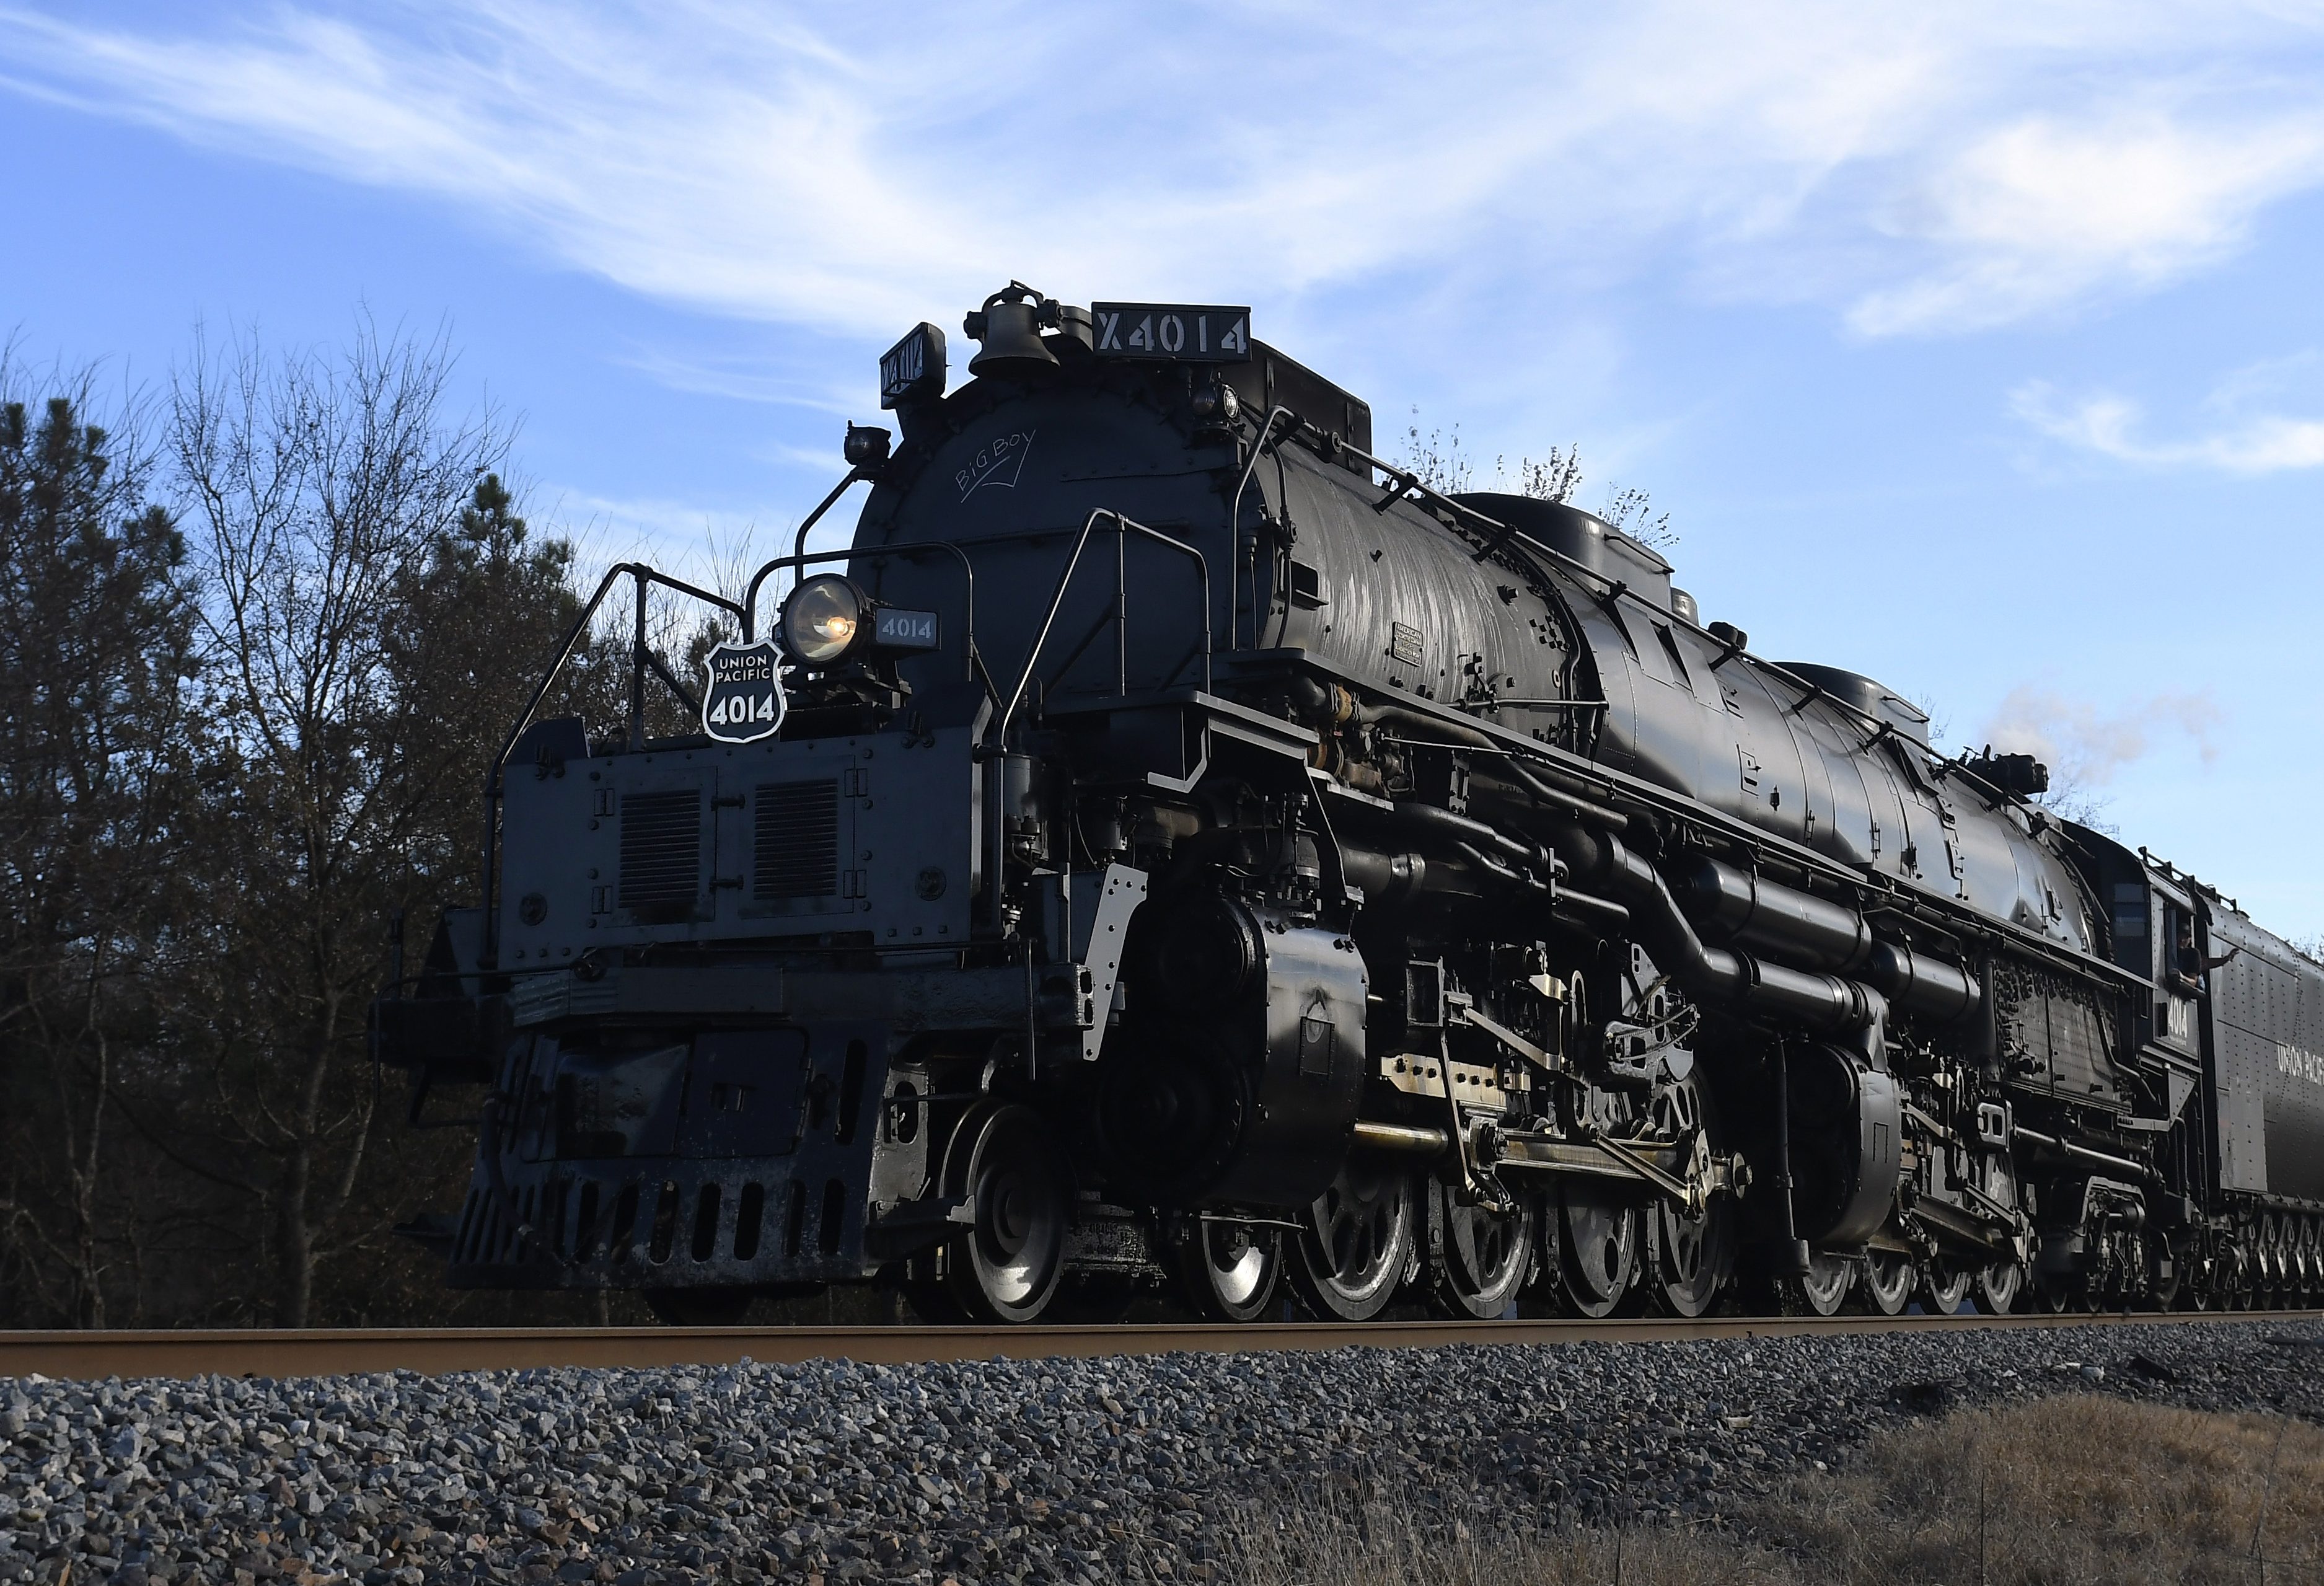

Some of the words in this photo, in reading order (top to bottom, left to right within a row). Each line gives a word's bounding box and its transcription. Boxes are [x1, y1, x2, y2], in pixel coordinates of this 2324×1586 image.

[1098, 312, 1247, 354] X4014
[882, 618, 931, 638] 4014
[716, 668, 770, 683] PACIFIC
[720, 654, 767, 669] UNION
[710, 692, 774, 726] 4014
[2168, 995, 2188, 1038] 4014
[2278, 1041, 2302, 1077] UNION
